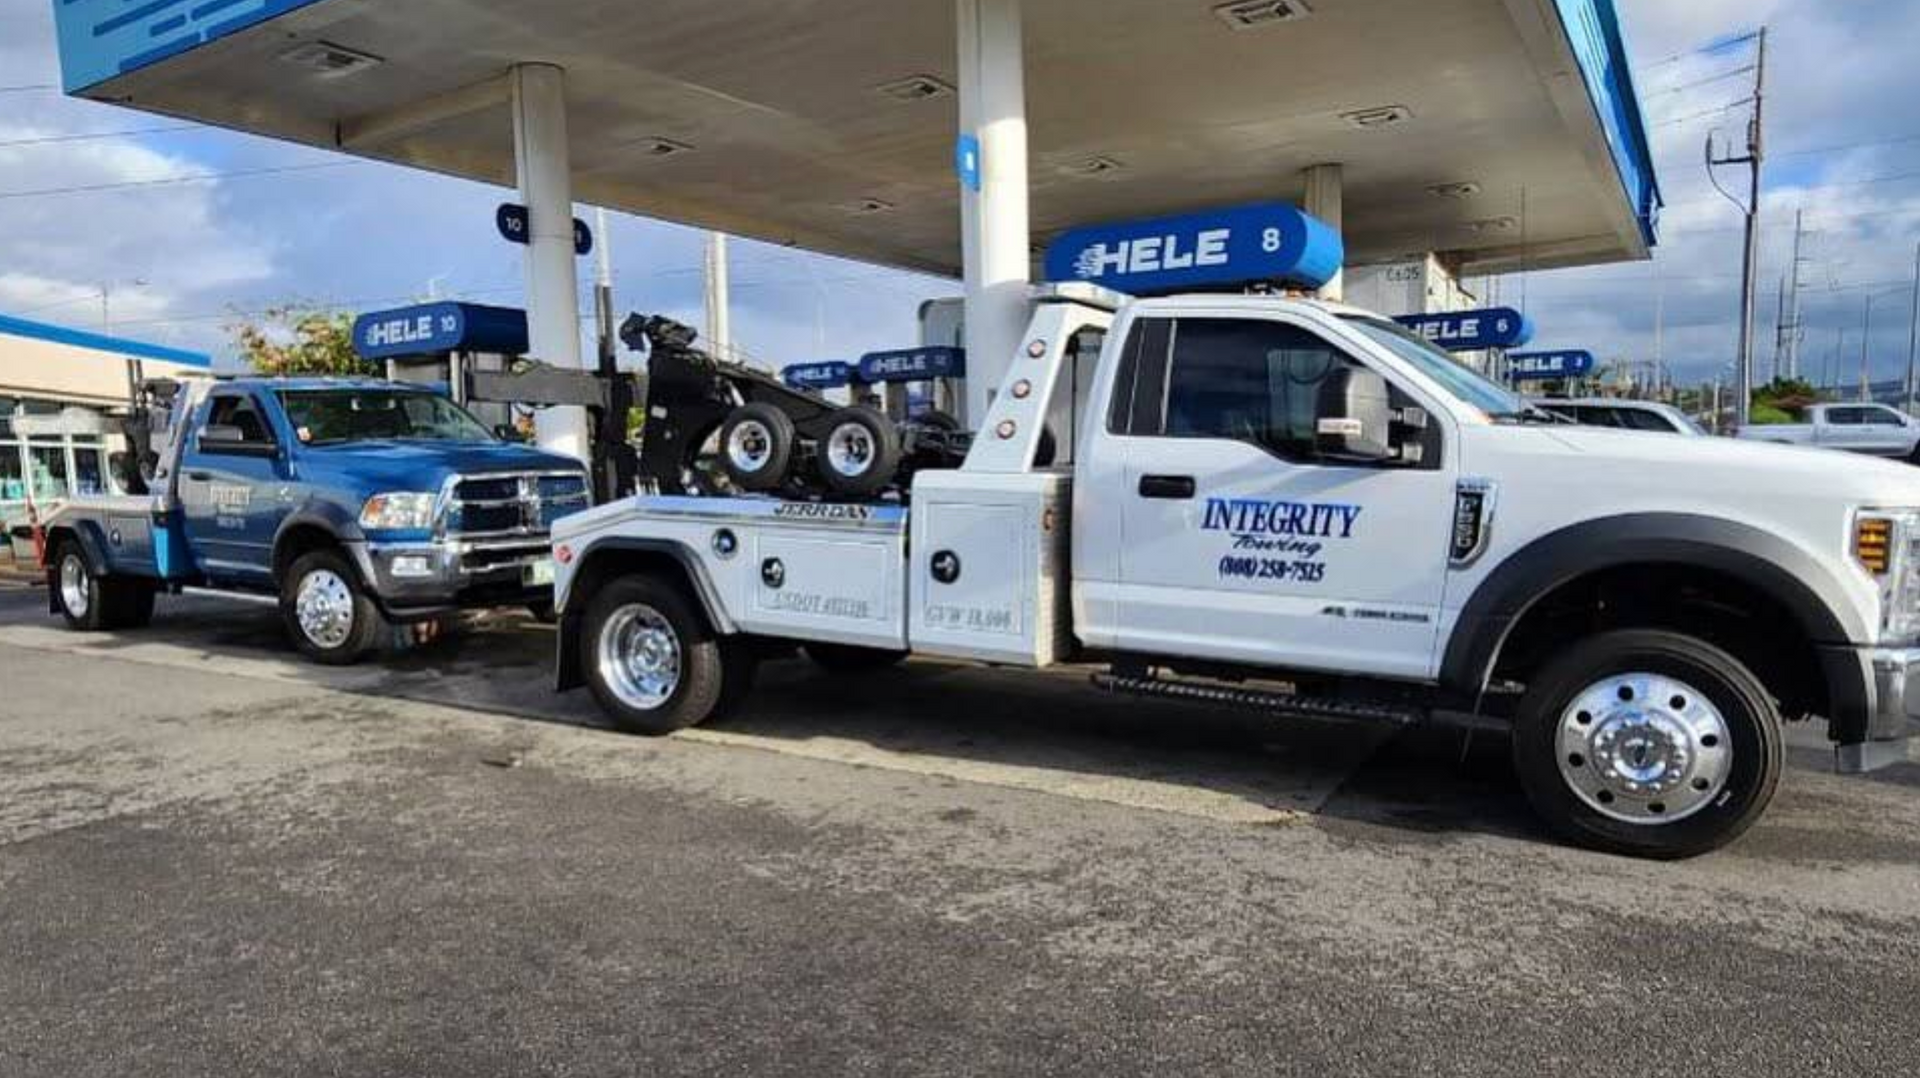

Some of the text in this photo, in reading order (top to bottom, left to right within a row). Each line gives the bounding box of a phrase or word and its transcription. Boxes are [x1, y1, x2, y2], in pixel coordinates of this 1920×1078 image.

[505, 217, 522, 232] 10
[1073, 227, 1281, 278] HELE 8
[367, 315, 457, 346] HELE 10
[1496, 318, 1508, 333] 6
[871, 355, 926, 373] HELE
[1201, 498, 1362, 538] INTEGRITY
[1230, 533, 1323, 559] Towing
[1218, 555, 1327, 583] (808) 258-7515
